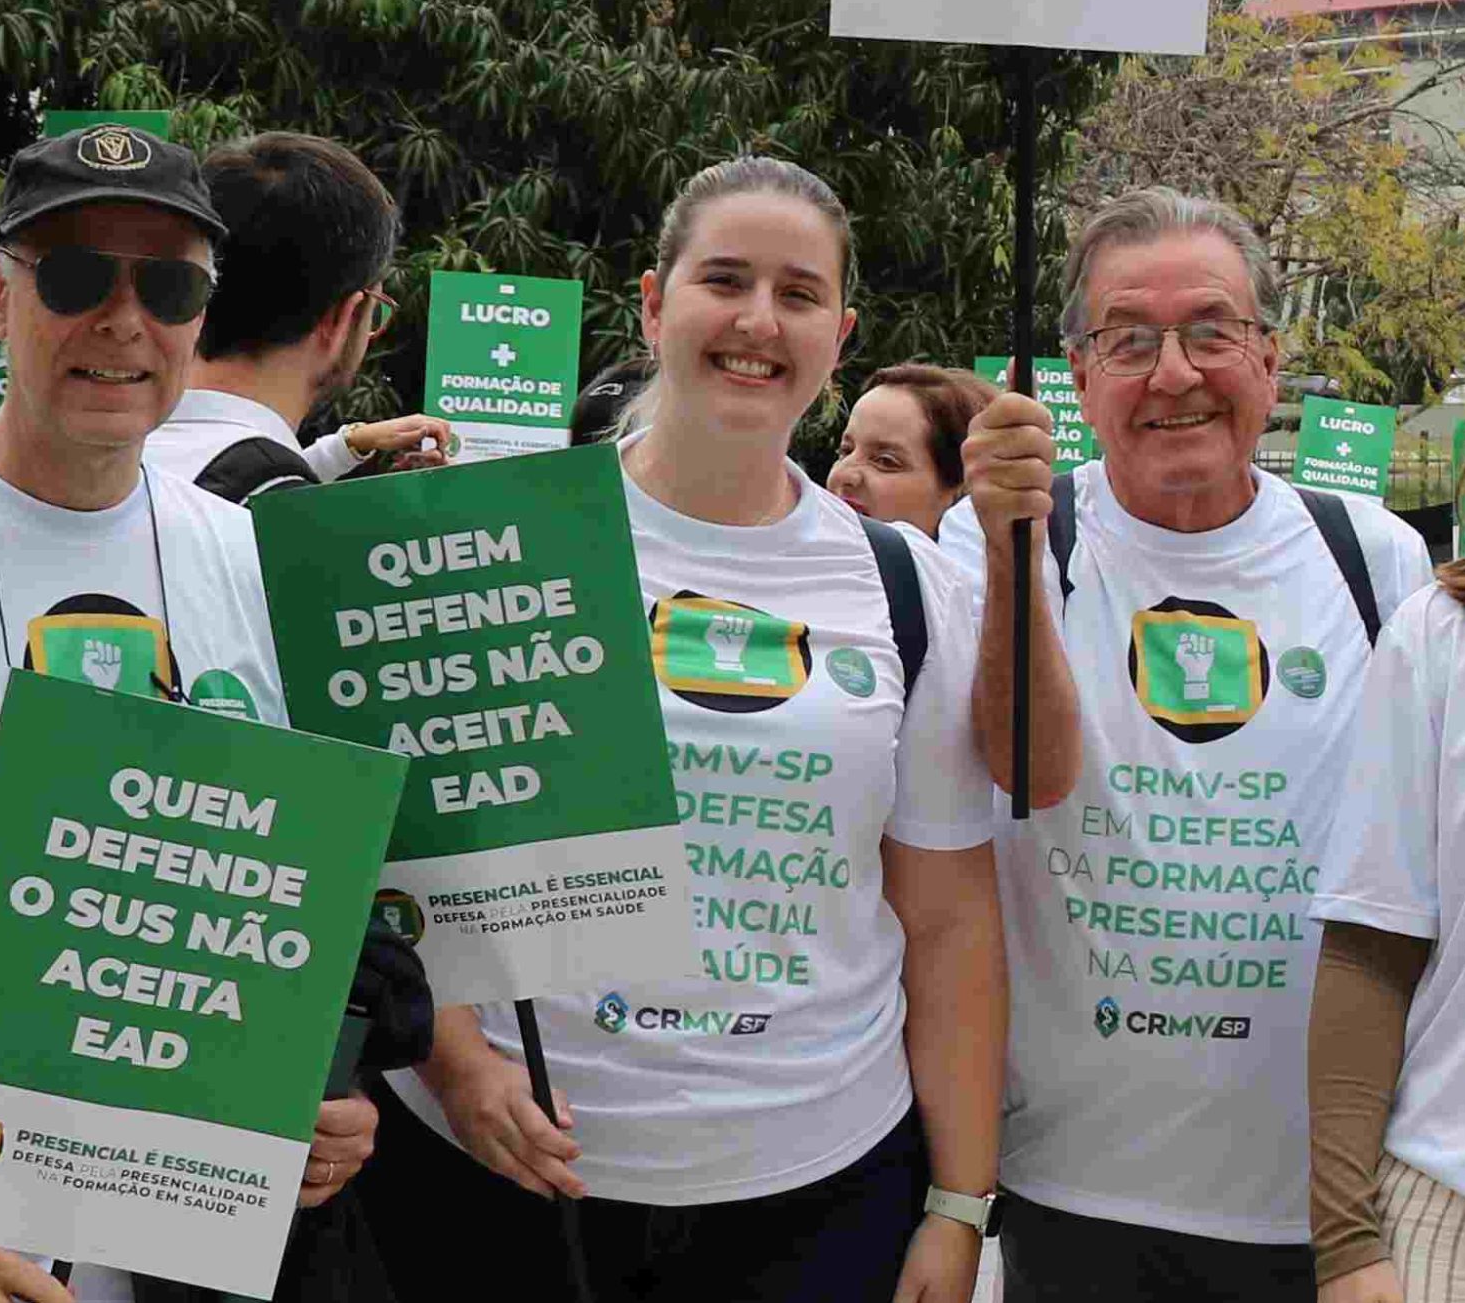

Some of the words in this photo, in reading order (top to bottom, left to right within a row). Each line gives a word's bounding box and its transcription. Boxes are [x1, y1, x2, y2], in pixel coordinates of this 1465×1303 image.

[461, 303, 551, 327] LUCRO
[442, 374, 534, 394] FORMAÇÃO
[538, 382, 562, 395] DE
[1036, 367, 1073, 384] ÚDE
[438, 395, 562, 417] QUALIDADE
[1059, 411, 1083, 422] NA
[1320, 416, 1376, 435] LUCRO
[1302, 470, 1377, 490] QUALIDADE
[1363, 465, 1379, 476] DE
[367, 524, 522, 587] QUEM
[335, 578, 575, 648] DEFENDE
[327, 668, 368, 708] O
[377, 654, 477, 702] SUS
[489, 632, 605, 689] NÃO
[387, 702, 572, 760] ACEITA
[109, 767, 277, 838] QUEM
[431, 765, 541, 814] EAD
[1109, 764, 1287, 800] CRMV-SP
[1081, 806, 1132, 839] EM
[1148, 813, 1301, 848] DEFESA
[44, 817, 308, 908] DEFENDE
[1047, 846, 1093, 882] DA
[1107, 856, 1319, 902] FORMAÇÃO
[428, 881, 543, 908] PRESENCIAL
[547, 875, 559, 891] É
[563, 867, 663, 890] ESSENCIAL
[434, 911, 485, 924] DEFESA
[531, 886, 667, 911] PRESENCIALIDADE
[9, 875, 55, 918] O
[64, 887, 177, 946] SUS
[186, 911, 311, 971] NÃO
[481, 910, 566, 934] FORMAÇÃO
[571, 909, 592, 920] EM
[1066, 896, 1304, 941] PRESENCIAL
[40, 948, 243, 1022] ACEITA
[1089, 948, 1138, 982] NA
[1149, 951, 1287, 988] SAÚDE
[635, 1007, 735, 1035] CRMV
[1126, 1011, 1215, 1038] CRMV
[69, 1015, 190, 1070] EAD
[12, 1150, 74, 1172] DEFESA
[121, 1169, 268, 1208] PRESENCIALIDADE
[16, 1129, 140, 1164] PRESENCIAL
[145, 1149, 159, 1166] É
[162, 1155, 271, 1190] ESSENCIAL
[63, 1176, 151, 1198] FORMAÇÃO
[155, 1190, 179, 1203] EM
